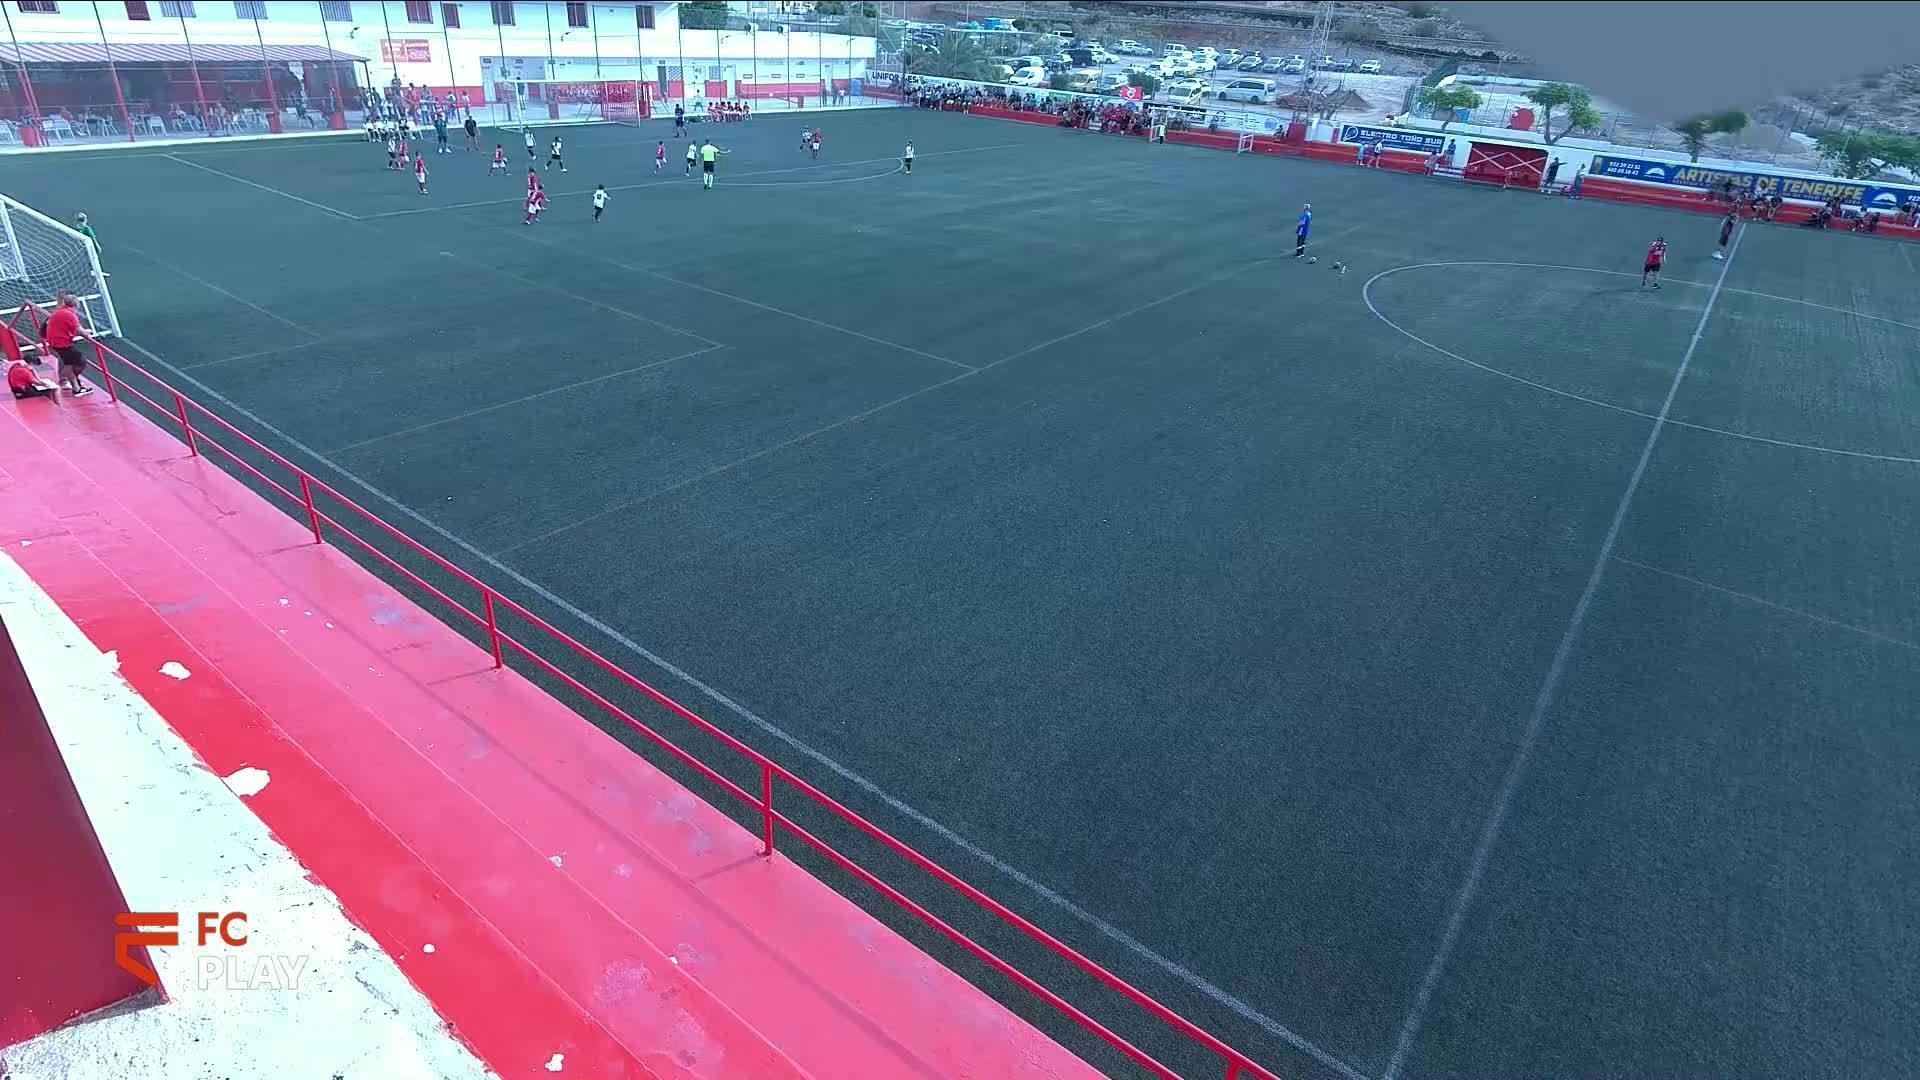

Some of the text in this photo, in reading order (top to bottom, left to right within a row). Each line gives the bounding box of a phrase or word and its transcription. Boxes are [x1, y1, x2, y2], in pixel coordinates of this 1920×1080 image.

[872, 72, 918, 84] UNIFORES
[1360, 129, 1398, 140] ELECTRO
[1424, 137, 1443, 145] SUR
[1755, 176, 1780, 190] DE
[1783, 179, 1866, 200] TENERIFE
